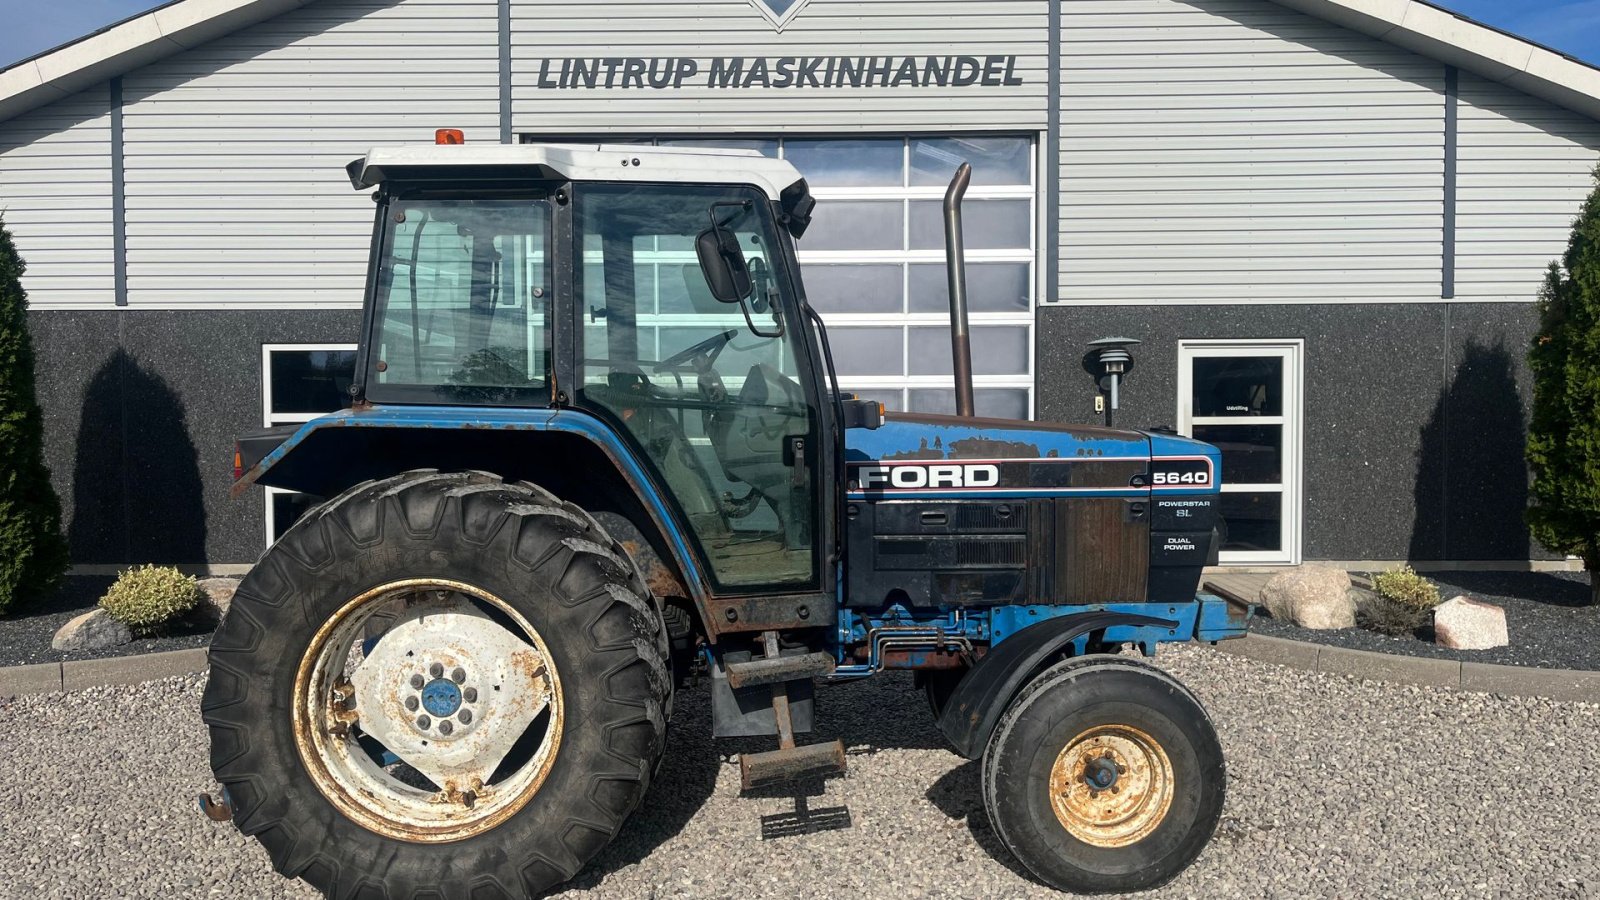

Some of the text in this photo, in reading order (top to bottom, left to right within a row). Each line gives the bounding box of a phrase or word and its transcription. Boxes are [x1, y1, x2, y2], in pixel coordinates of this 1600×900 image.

[537, 54, 1023, 89] LINTRUP MASKINHANDEL
[858, 464, 999, 488] FORD
[1153, 472, 1208, 483] 5640
[1176, 509, 1192, 517] SL
